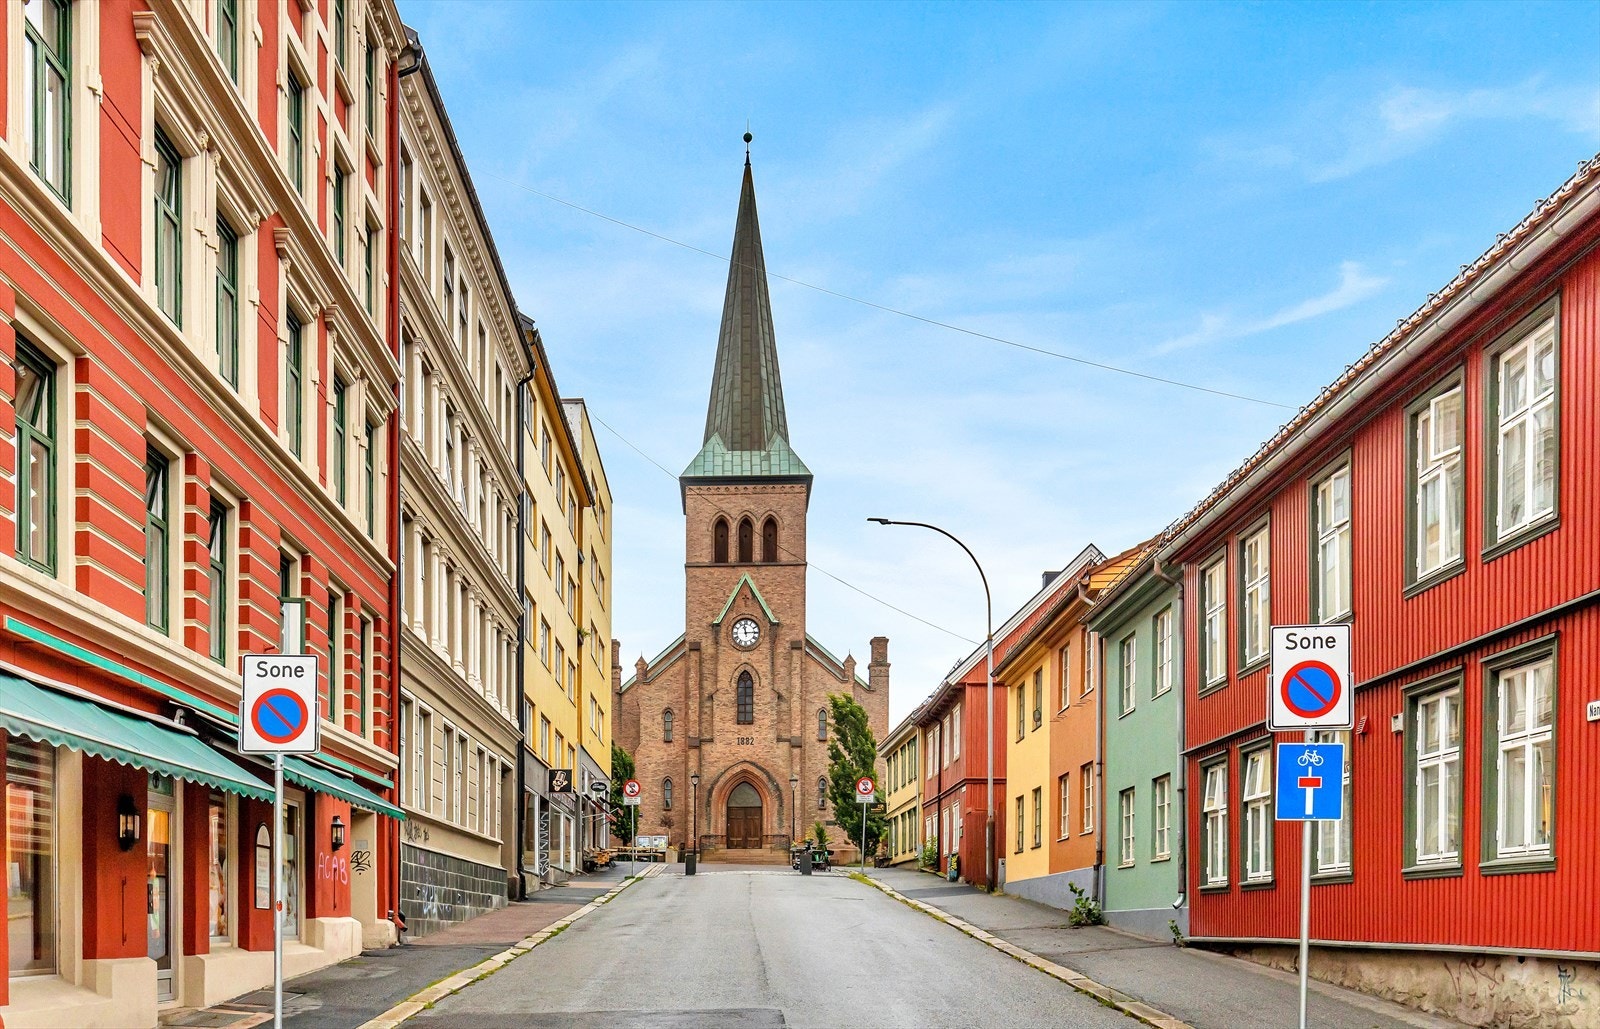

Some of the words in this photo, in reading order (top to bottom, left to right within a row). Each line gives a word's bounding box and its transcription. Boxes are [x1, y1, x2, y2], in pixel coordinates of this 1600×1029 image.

[1285, 632, 1337, 650] Sone
[256, 660, 305, 678] Sone
[736, 736, 755, 746] 1882
[318, 851, 348, 886] ACAB
